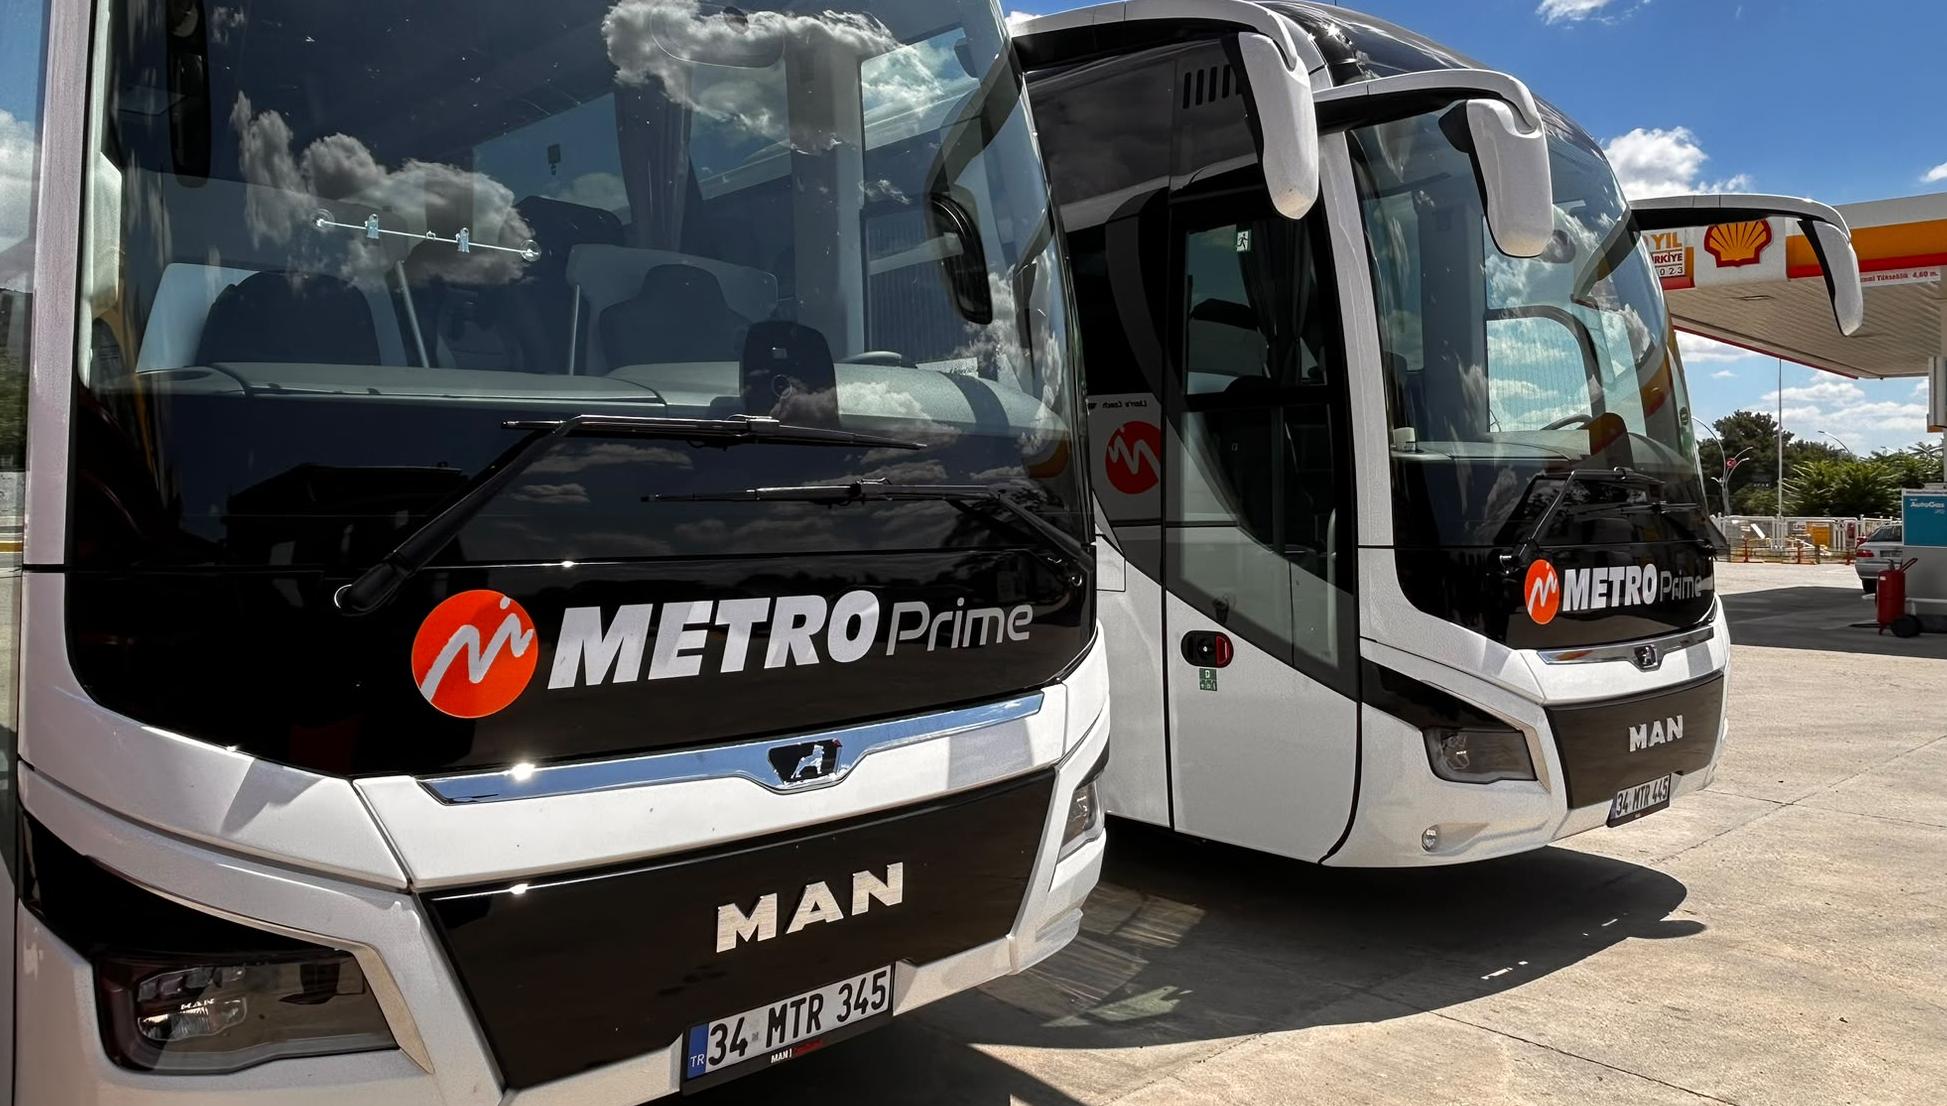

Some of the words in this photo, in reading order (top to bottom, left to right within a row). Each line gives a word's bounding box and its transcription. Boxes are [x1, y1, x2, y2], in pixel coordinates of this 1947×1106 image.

[1651, 232, 1682, 250] YIL
[1652, 251, 1682, 264] RKİYE
[1657, 266, 1683, 275] 023
[1562, 563, 1657, 612] METRO
[1659, 570, 1702, 601] Prime
[548, 590, 880, 689] METRO
[886, 597, 1033, 656] Prime
[1629, 715, 1683, 752] MAN
[1616, 792, 1629, 816] 34
[1632, 784, 1651, 811] MTR
[1652, 777, 1669, 803] 445
[716, 862, 904, 953] MAN
[708, 1016, 748, 1066] 34
[765, 993, 824, 1048] MTR
[836, 970, 887, 1023] 345
[690, 1053, 706, 1068] TR
[770, 1049, 789, 1064] MAN
